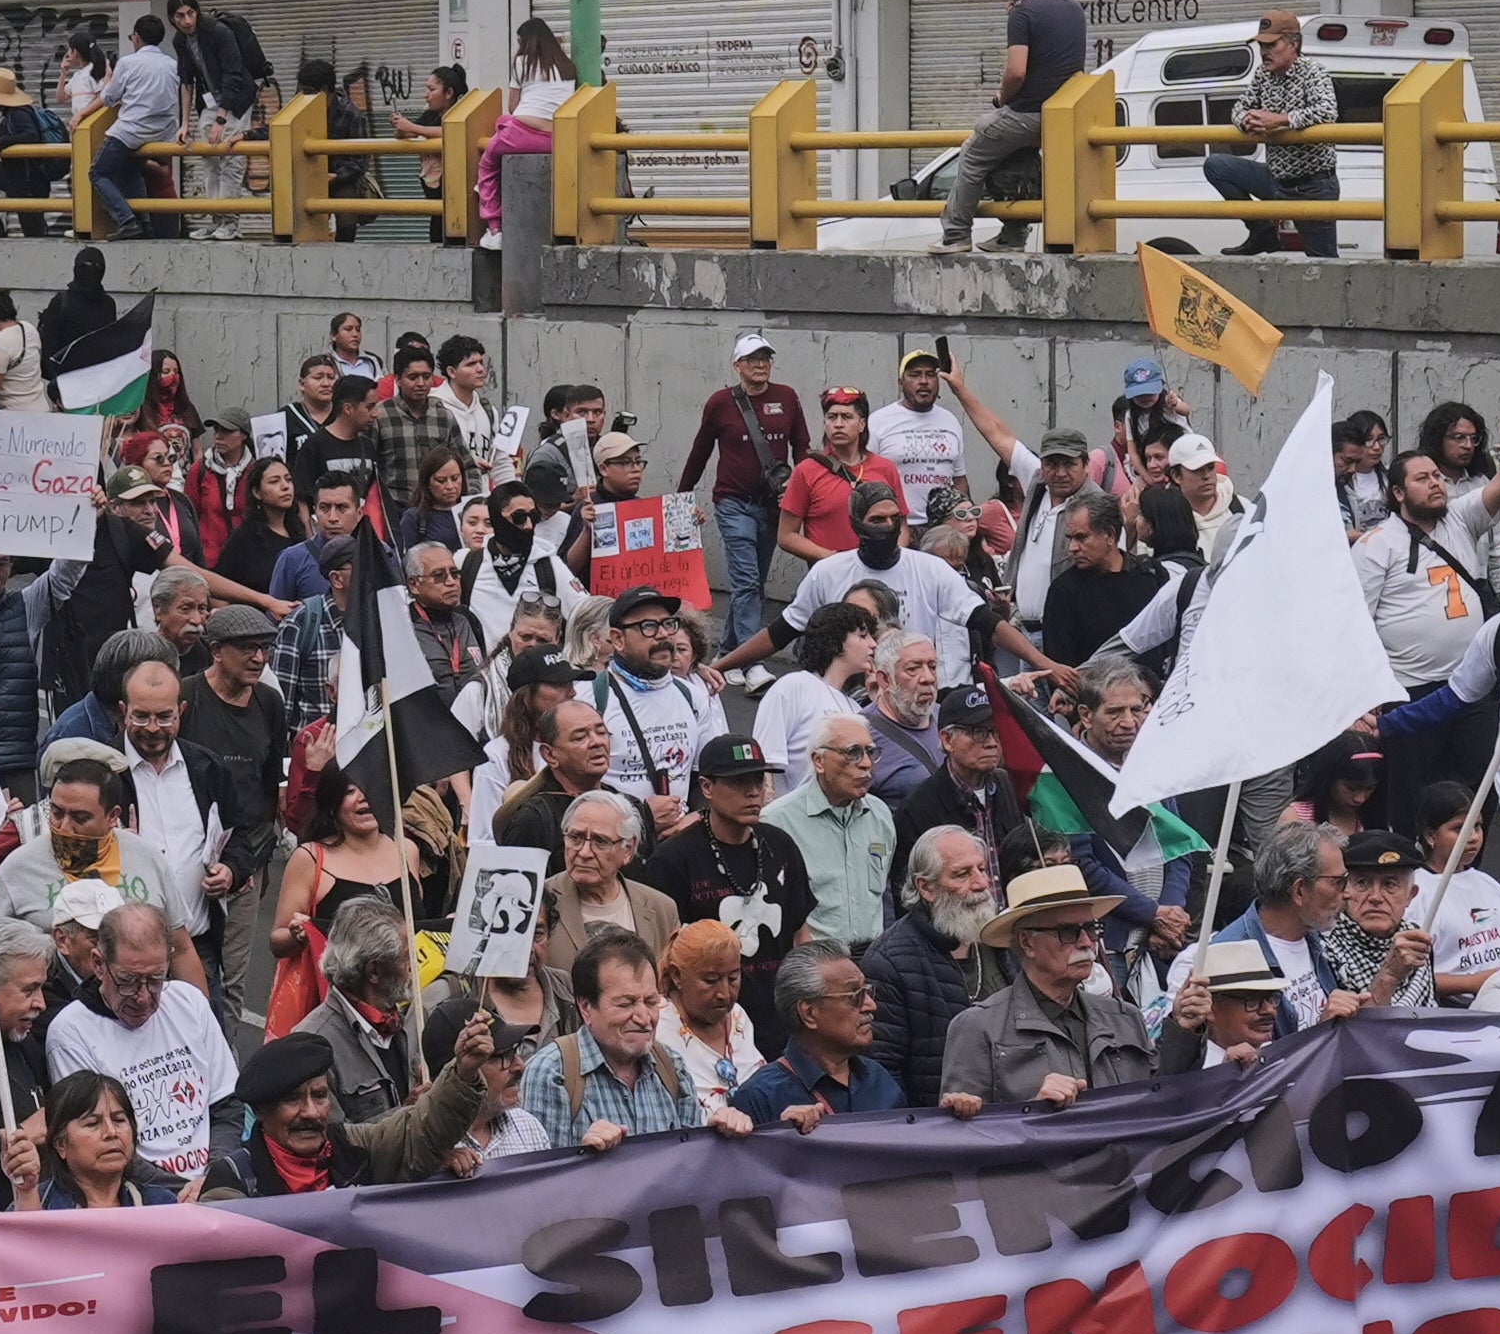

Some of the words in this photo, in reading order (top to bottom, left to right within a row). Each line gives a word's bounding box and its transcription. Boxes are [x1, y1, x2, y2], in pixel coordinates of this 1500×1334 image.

[716, 39, 753, 51] SEDEMA
[618, 63, 649, 75] CIUDAD
[652, 63, 664, 74] DE
[667, 62, 700, 74] MÉXICO
[32, 459, 94, 494] Gaza
[1426, 564, 1469, 621] 7
[521, 1075, 1424, 1324] SILENCIO
